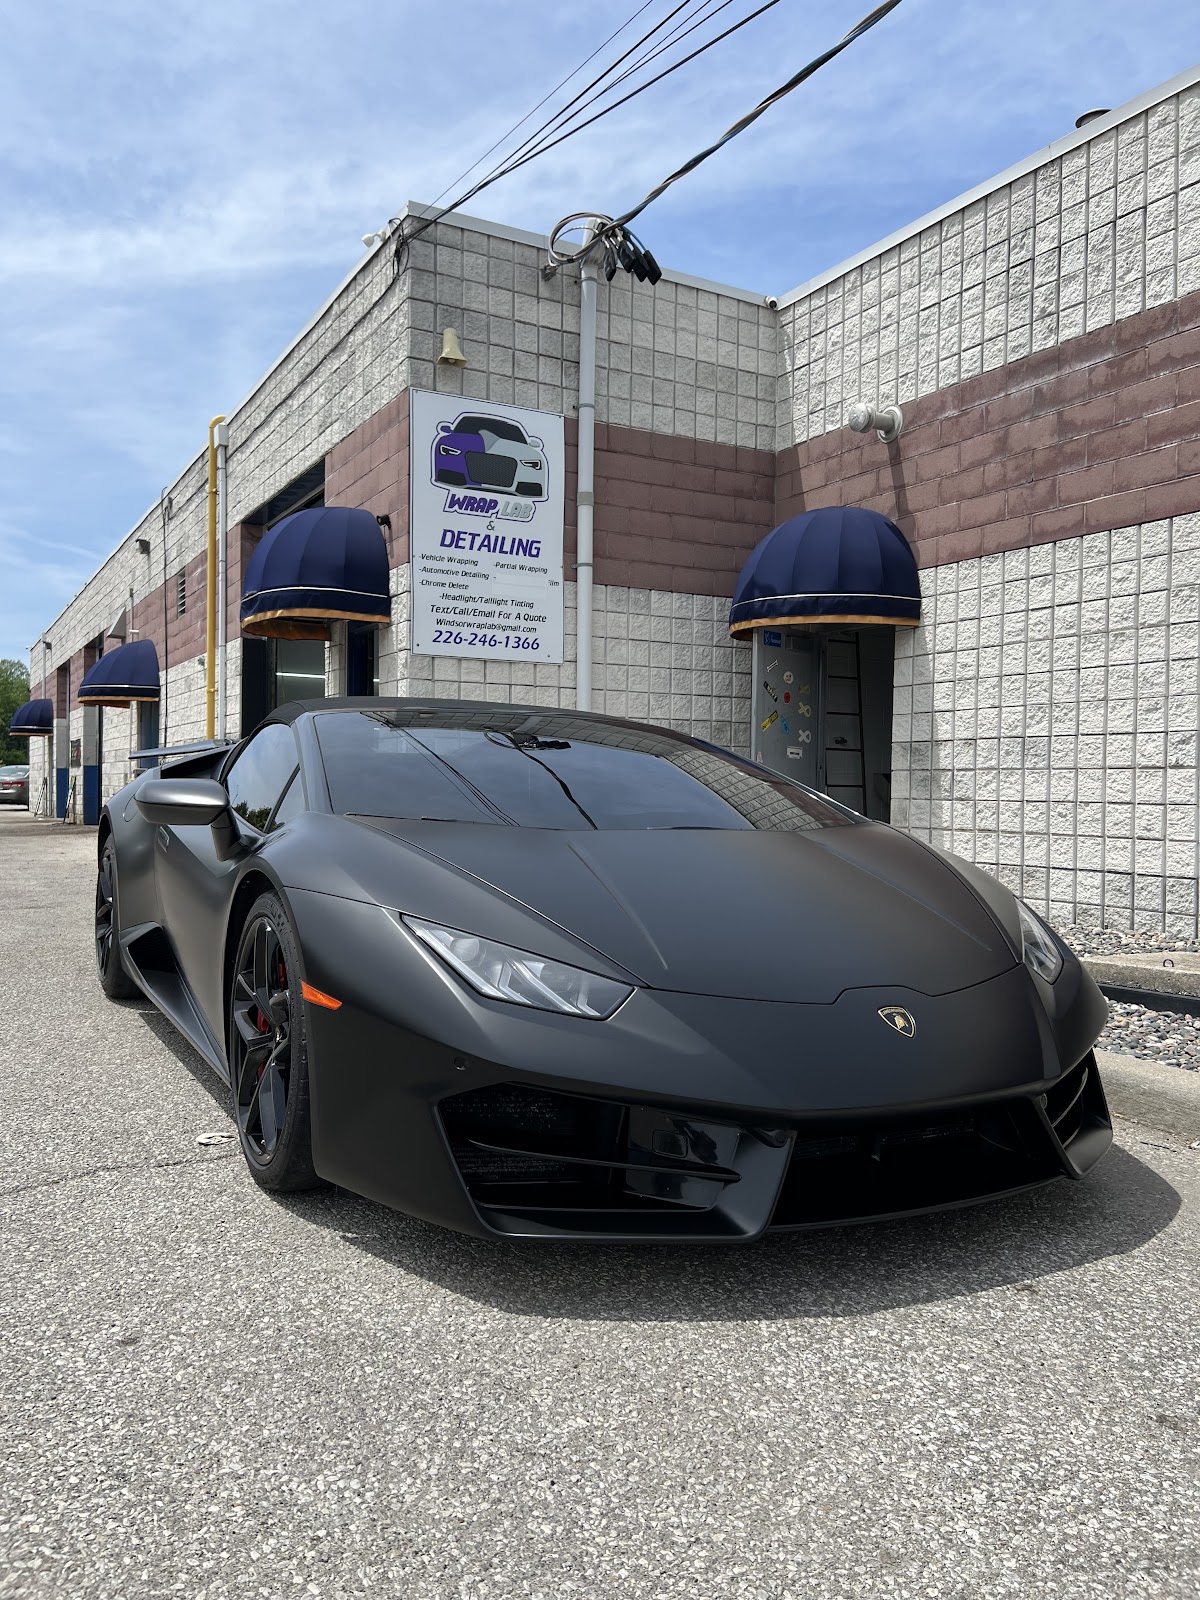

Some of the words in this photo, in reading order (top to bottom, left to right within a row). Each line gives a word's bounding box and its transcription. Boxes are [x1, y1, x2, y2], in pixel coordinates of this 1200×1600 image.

[448, 493, 499, 514] WRAP
[500, 500, 533, 519] LAB
[486, 520, 495, 531] &
[439, 529, 542, 558] DETAILING
[447, 556, 479, 567] Wrapping
[518, 564, 548, 575] Wrapping
[460, 570, 490, 581] Detailing
[448, 581, 470, 590] Delete
[510, 599, 535, 610] Tinting
[430, 604, 496, 619] Text/Call/Email
[498, 610, 512, 620] For
[514, 612, 521, 621] A
[523, 613, 547, 623] Quote
[436, 618, 537, 634] Windsorwraplab@gmail.com
[431, 629, 541, 650] 226-246-1366
